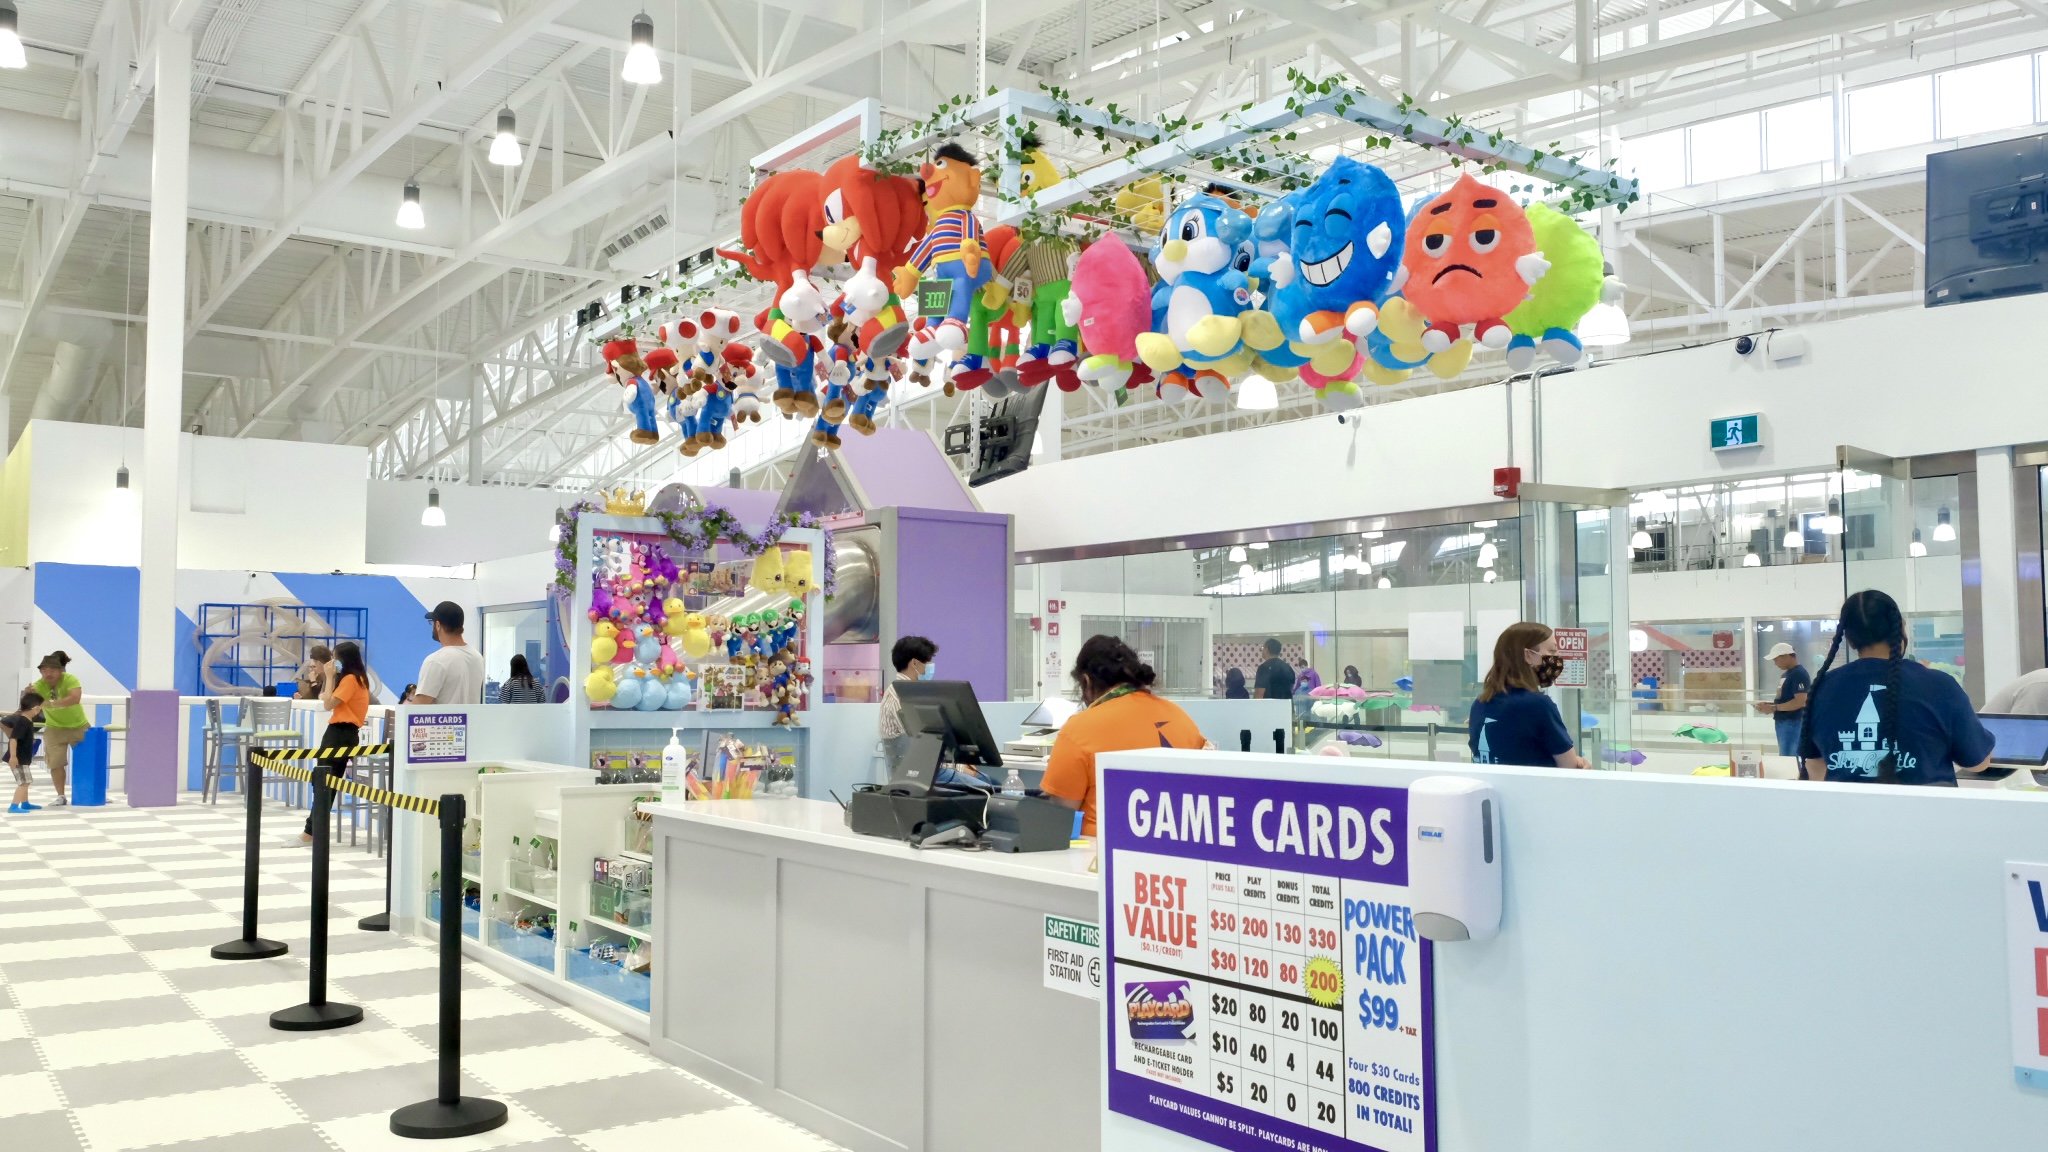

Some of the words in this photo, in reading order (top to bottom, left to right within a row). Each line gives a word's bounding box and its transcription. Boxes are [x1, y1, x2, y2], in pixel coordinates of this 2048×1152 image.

[1559, 636, 1584, 650] OPEN
[413, 716, 436, 724] GAME
[438, 716, 462, 724] CARDS
[1862, 751, 1916, 773] Ctle
[1128, 788, 1236, 847] GAME
[1252, 798, 1395, 866] CARDS
[1134, 871, 1187, 911] BEST
[1215, 872, 1231, 882] PRICE
[1247, 876, 1262, 886] PLAY
[1277, 880, 1298, 891] BONUS
[1311, 884, 1330, 896] TOTAL
[1243, 888, 1266, 899] CREDITS
[1276, 893, 1300, 905] CREDITS
[1309, 898, 1334, 910] CREDITS
[1047, 919, 1079, 941] SAFETY
[1080, 926, 1100, 947] FIRS
[1123, 903, 1197, 949] VALUE
[1210, 909, 1236, 932] $50
[1242, 916, 1268, 938] 200
[1275, 922, 1301, 945] 130
[1309, 927, 1336, 951] 330
[1344, 898, 1416, 943] POWER
[1047, 947, 1069, 964] FIRST
[1070, 953, 1084, 968] AID
[1211, 948, 1237, 972] $30
[1243, 956, 1269, 979] 120
[1280, 963, 1298, 984] 80
[1310, 969, 1338, 993] 200
[1355, 933, 1406, 986] PACK
[1049, 963, 1081, 983] STATION
[1129, 999, 1191, 1019] PLAYCARD
[1212, 993, 1237, 1017] $20
[1249, 1003, 1266, 1024] 80
[1281, 1010, 1299, 1032] 20
[1311, 1017, 1338, 1042] 100
[1359, 988, 1399, 1031] $99
[1405, 1026, 1417, 1037] TAX
[1133, 1054, 1146, 1065] AND
[1147, 1058, 1170, 1072] E-TICKET
[1171, 1065, 1194, 1079] HOLDER
[1134, 1041, 1176, 1060] RECHARGEABLE
[1177, 1053, 1193, 1065] CARD
[1212, 1031, 1238, 1055] $10
[1250, 1043, 1267, 1064] 40
[1286, 1052, 1295, 1072] 4
[1316, 1060, 1334, 1082] 44
[1348, 1057, 1368, 1073] Four
[1371, 1062, 1390, 1078] $30
[1393, 1068, 1420, 1087] Cards
[1217, 1071, 1234, 1094] $5
[1250, 1082, 1268, 1104] 20
[1287, 1093, 1296, 1112] 0
[1317, 1101, 1336, 1124] 20
[1348, 1078, 1370, 1097] 800
[1373, 1084, 1420, 1111] CREDITS
[1149, 1095, 1178, 1111] PLAYCARD
[1179, 1104, 1201, 1119] VALUES
[1202, 1111, 1227, 1127] CANNOT
[1228, 1120, 1237, 1131] BE
[1237, 1123, 1257, 1137] SPLIT.
[1258, 1129, 1296, 1149] PLAYCARDS
[1356, 1103, 1370, 1121] IN
[1373, 1108, 1413, 1134] TOTAL!
